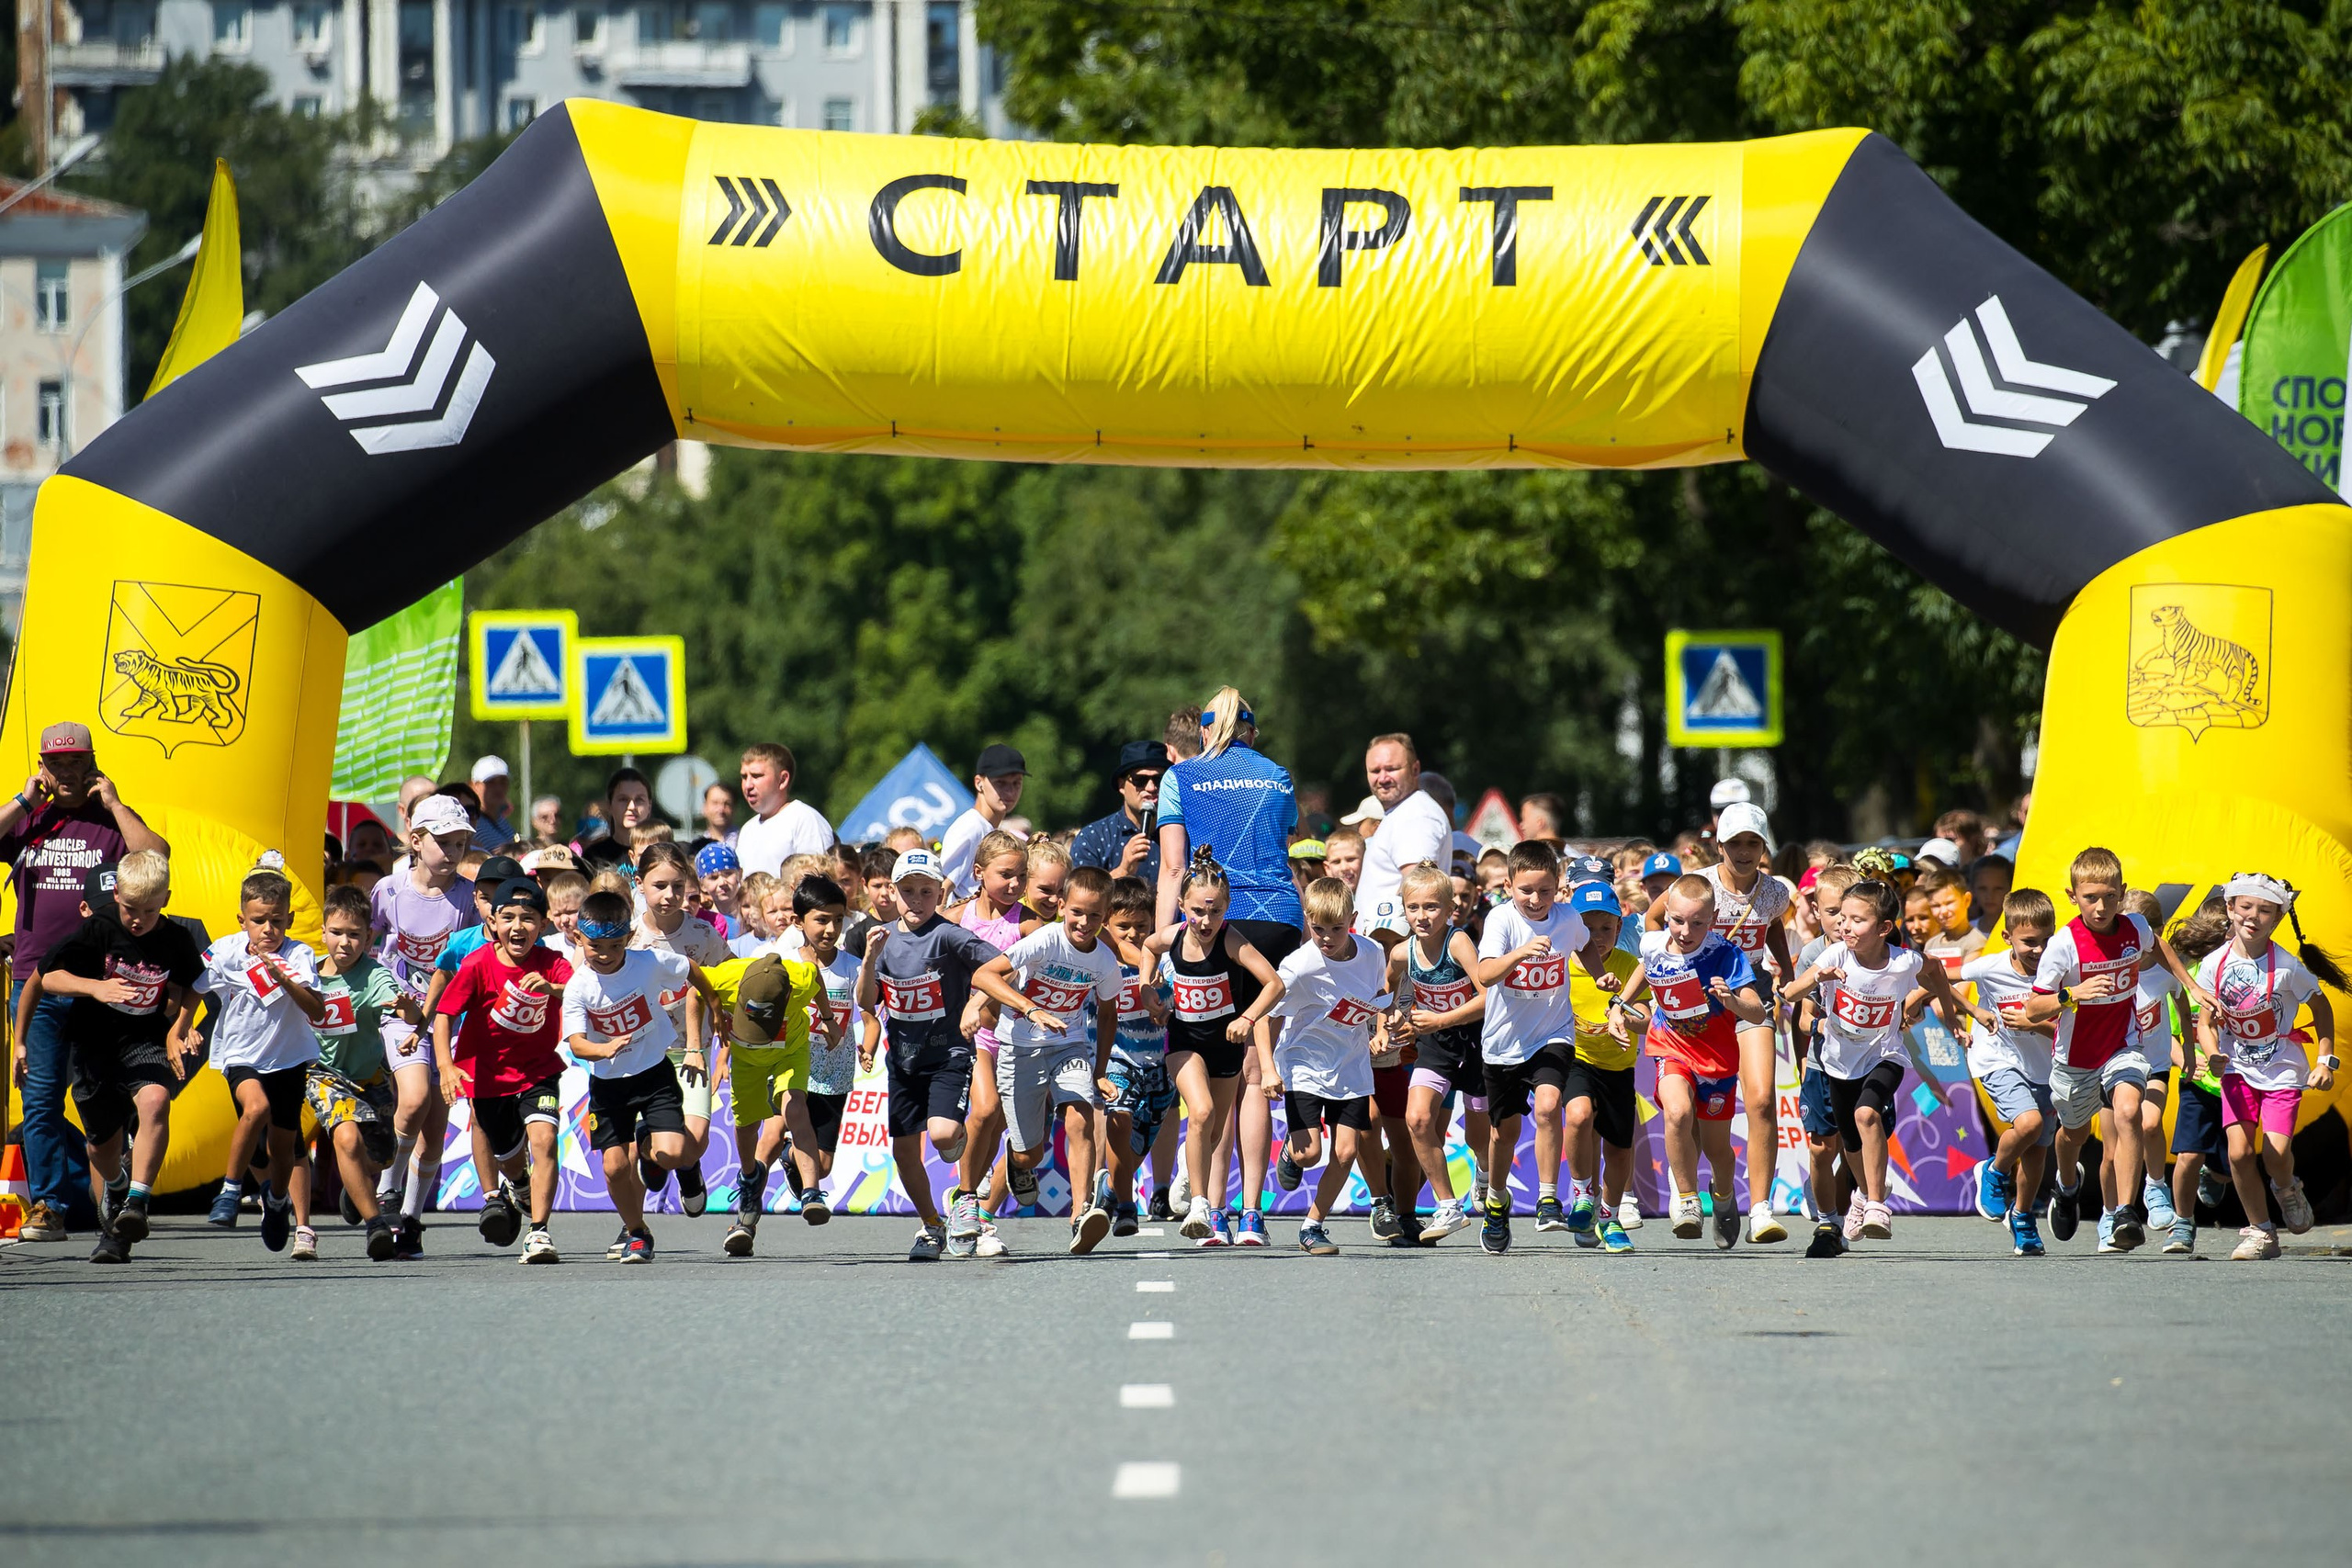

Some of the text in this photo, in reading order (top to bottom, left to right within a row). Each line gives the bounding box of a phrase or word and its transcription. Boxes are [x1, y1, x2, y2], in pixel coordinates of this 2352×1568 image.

[868, 173, 1554, 287] СТАРТ
[404, 937, 447, 960] 327
[2112, 955, 2138, 968] ПЕРВЫХ
[901, 975, 933, 987] ПЕРВЫХ
[1040, 976, 1063, 987] ЗАБЕГ
[1193, 976, 1223, 985] ПЕРВЫХ
[1436, 980, 1465, 991] ПЕРВЫХ
[1511, 964, 1560, 987] 206
[1661, 973, 1691, 985] ПЕРВЫХ
[508, 986, 529, 1003] ЗАБЕГ
[610, 991, 639, 1011] ПЕРВЫХ
[888, 987, 933, 1010] 375
[1030, 986, 1081, 1010] 294
[1177, 987, 1224, 1010] 389
[1663, 988, 1680, 1009] 4
[1841, 985, 1862, 998] ЗАБЕГ
[1998, 993, 2020, 1001] ЗАБЕГ
[500, 996, 547, 1024] 306
[1350, 996, 1373, 1010] ЗАБЕГ
[1838, 996, 1888, 1025] 287
[2235, 1004, 2267, 1017] ПЕРВЫХ
[597, 1005, 640, 1034] 315
[838, 1122, 889, 1147] ВЫХ
